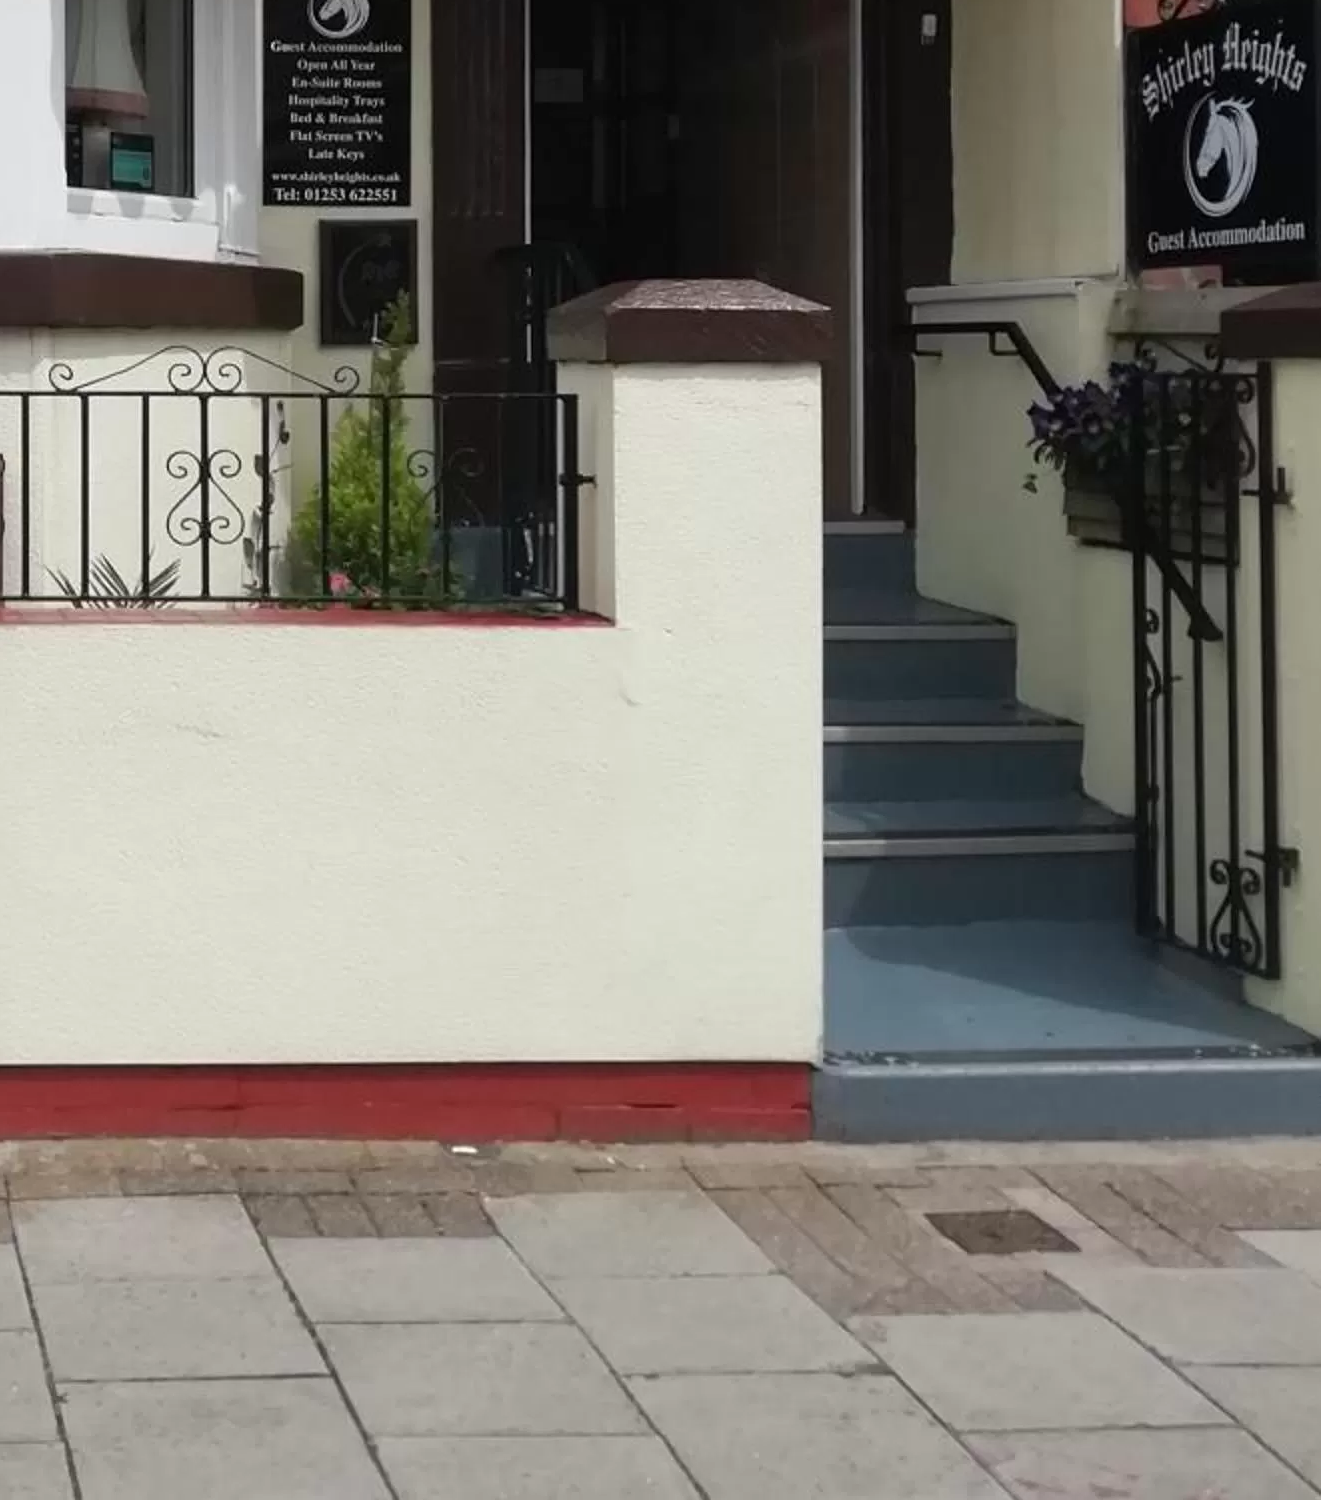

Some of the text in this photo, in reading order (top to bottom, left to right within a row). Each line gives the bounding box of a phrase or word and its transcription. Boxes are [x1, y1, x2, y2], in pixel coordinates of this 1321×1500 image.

[270, 40, 403, 53] Guest Accommodation
[296, 58, 376, 72] Open All Year
[1142, 21, 1308, 122] Shirley Heights
[291, 76, 383, 89] En-Suite Rooms
[287, 94, 386, 109] Hospitality Trays
[289, 112, 384, 124] Bed & Breakfast
[289, 130, 384, 142] Flat Screen TV's
[307, 148, 365, 162] Late Keys
[271, 171, 402, 183] www.shirleyheights.co.uk
[273, 187, 398, 202] Tel: 01253 622551
[1147, 217, 1306, 254] Guest Accommodation
